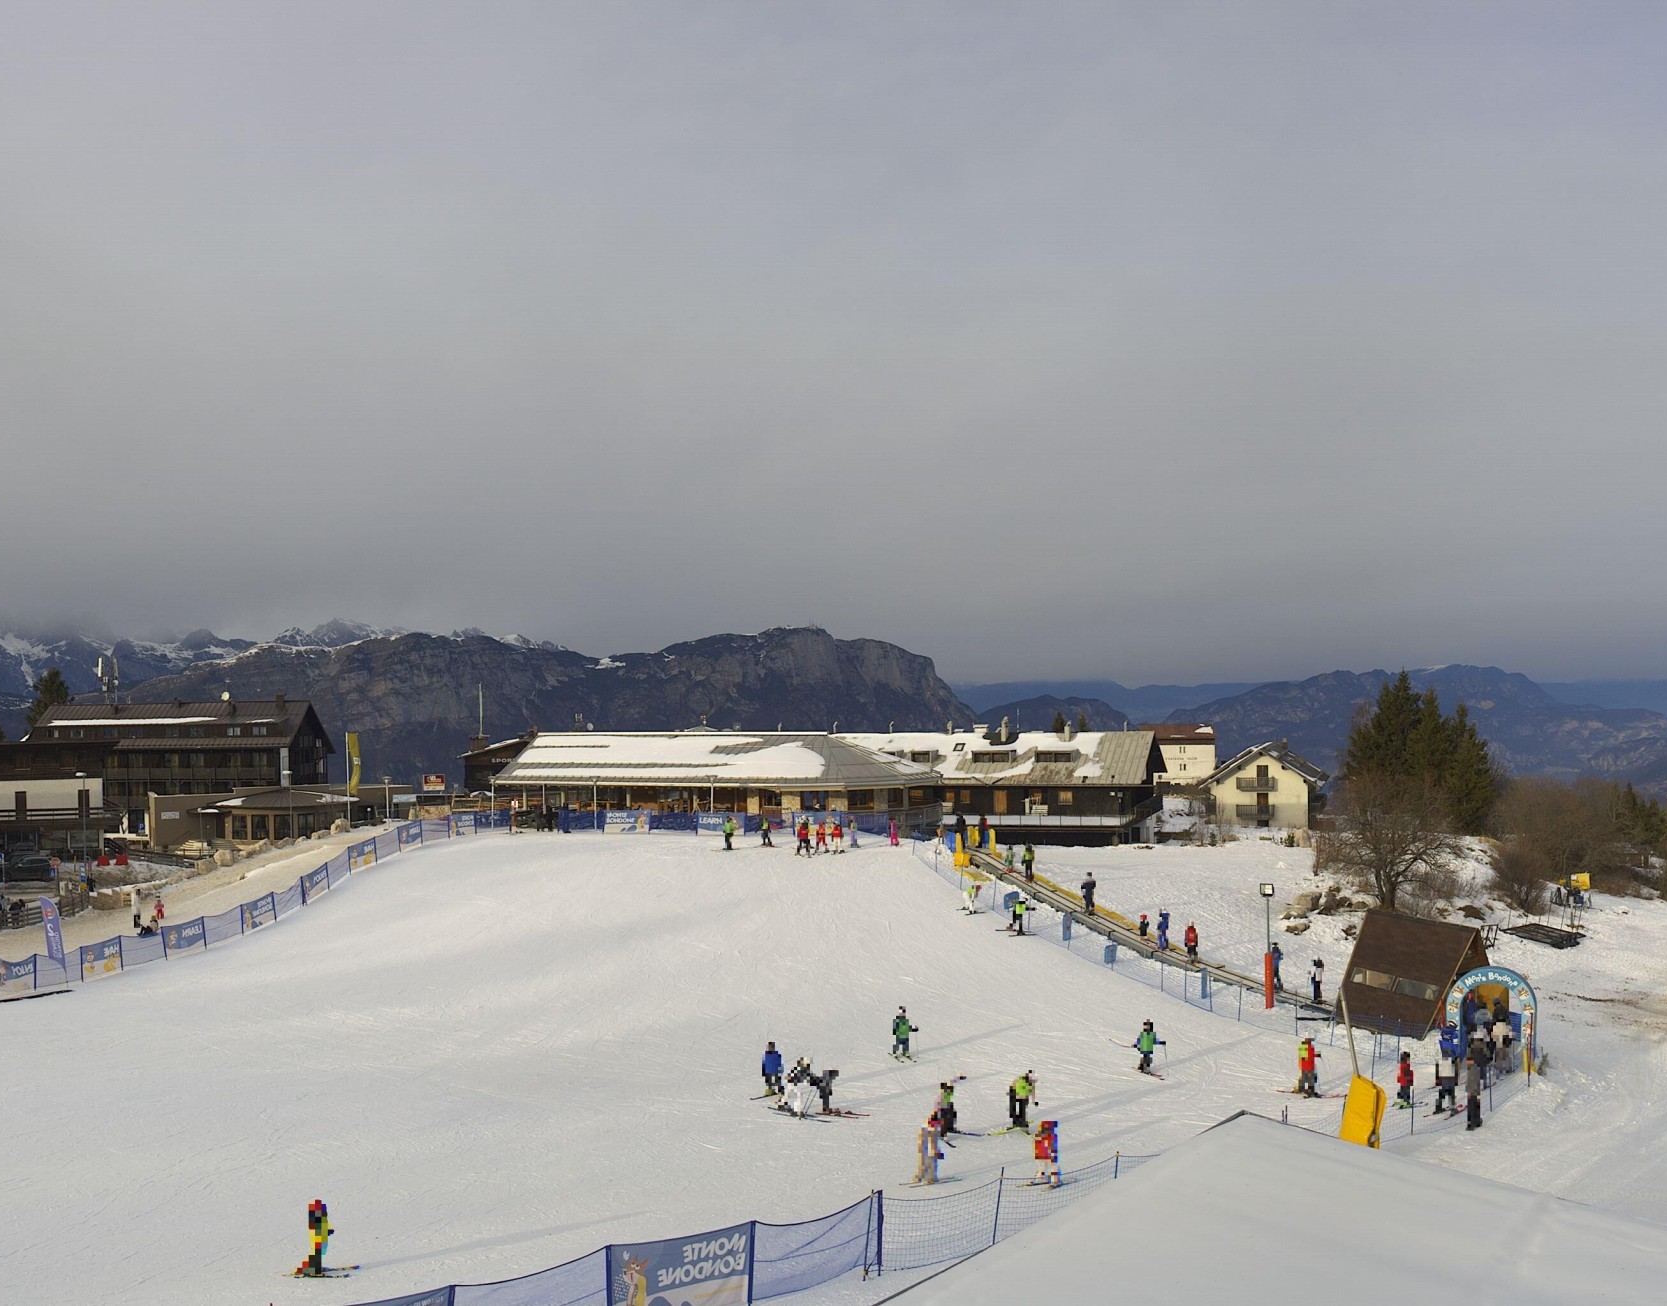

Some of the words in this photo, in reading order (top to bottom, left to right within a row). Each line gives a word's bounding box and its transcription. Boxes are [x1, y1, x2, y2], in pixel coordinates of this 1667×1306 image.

[698, 816, 723, 824] LEARN
[1464, 972, 1487, 988] Monte
[1488, 971, 1519, 987] Bondone
